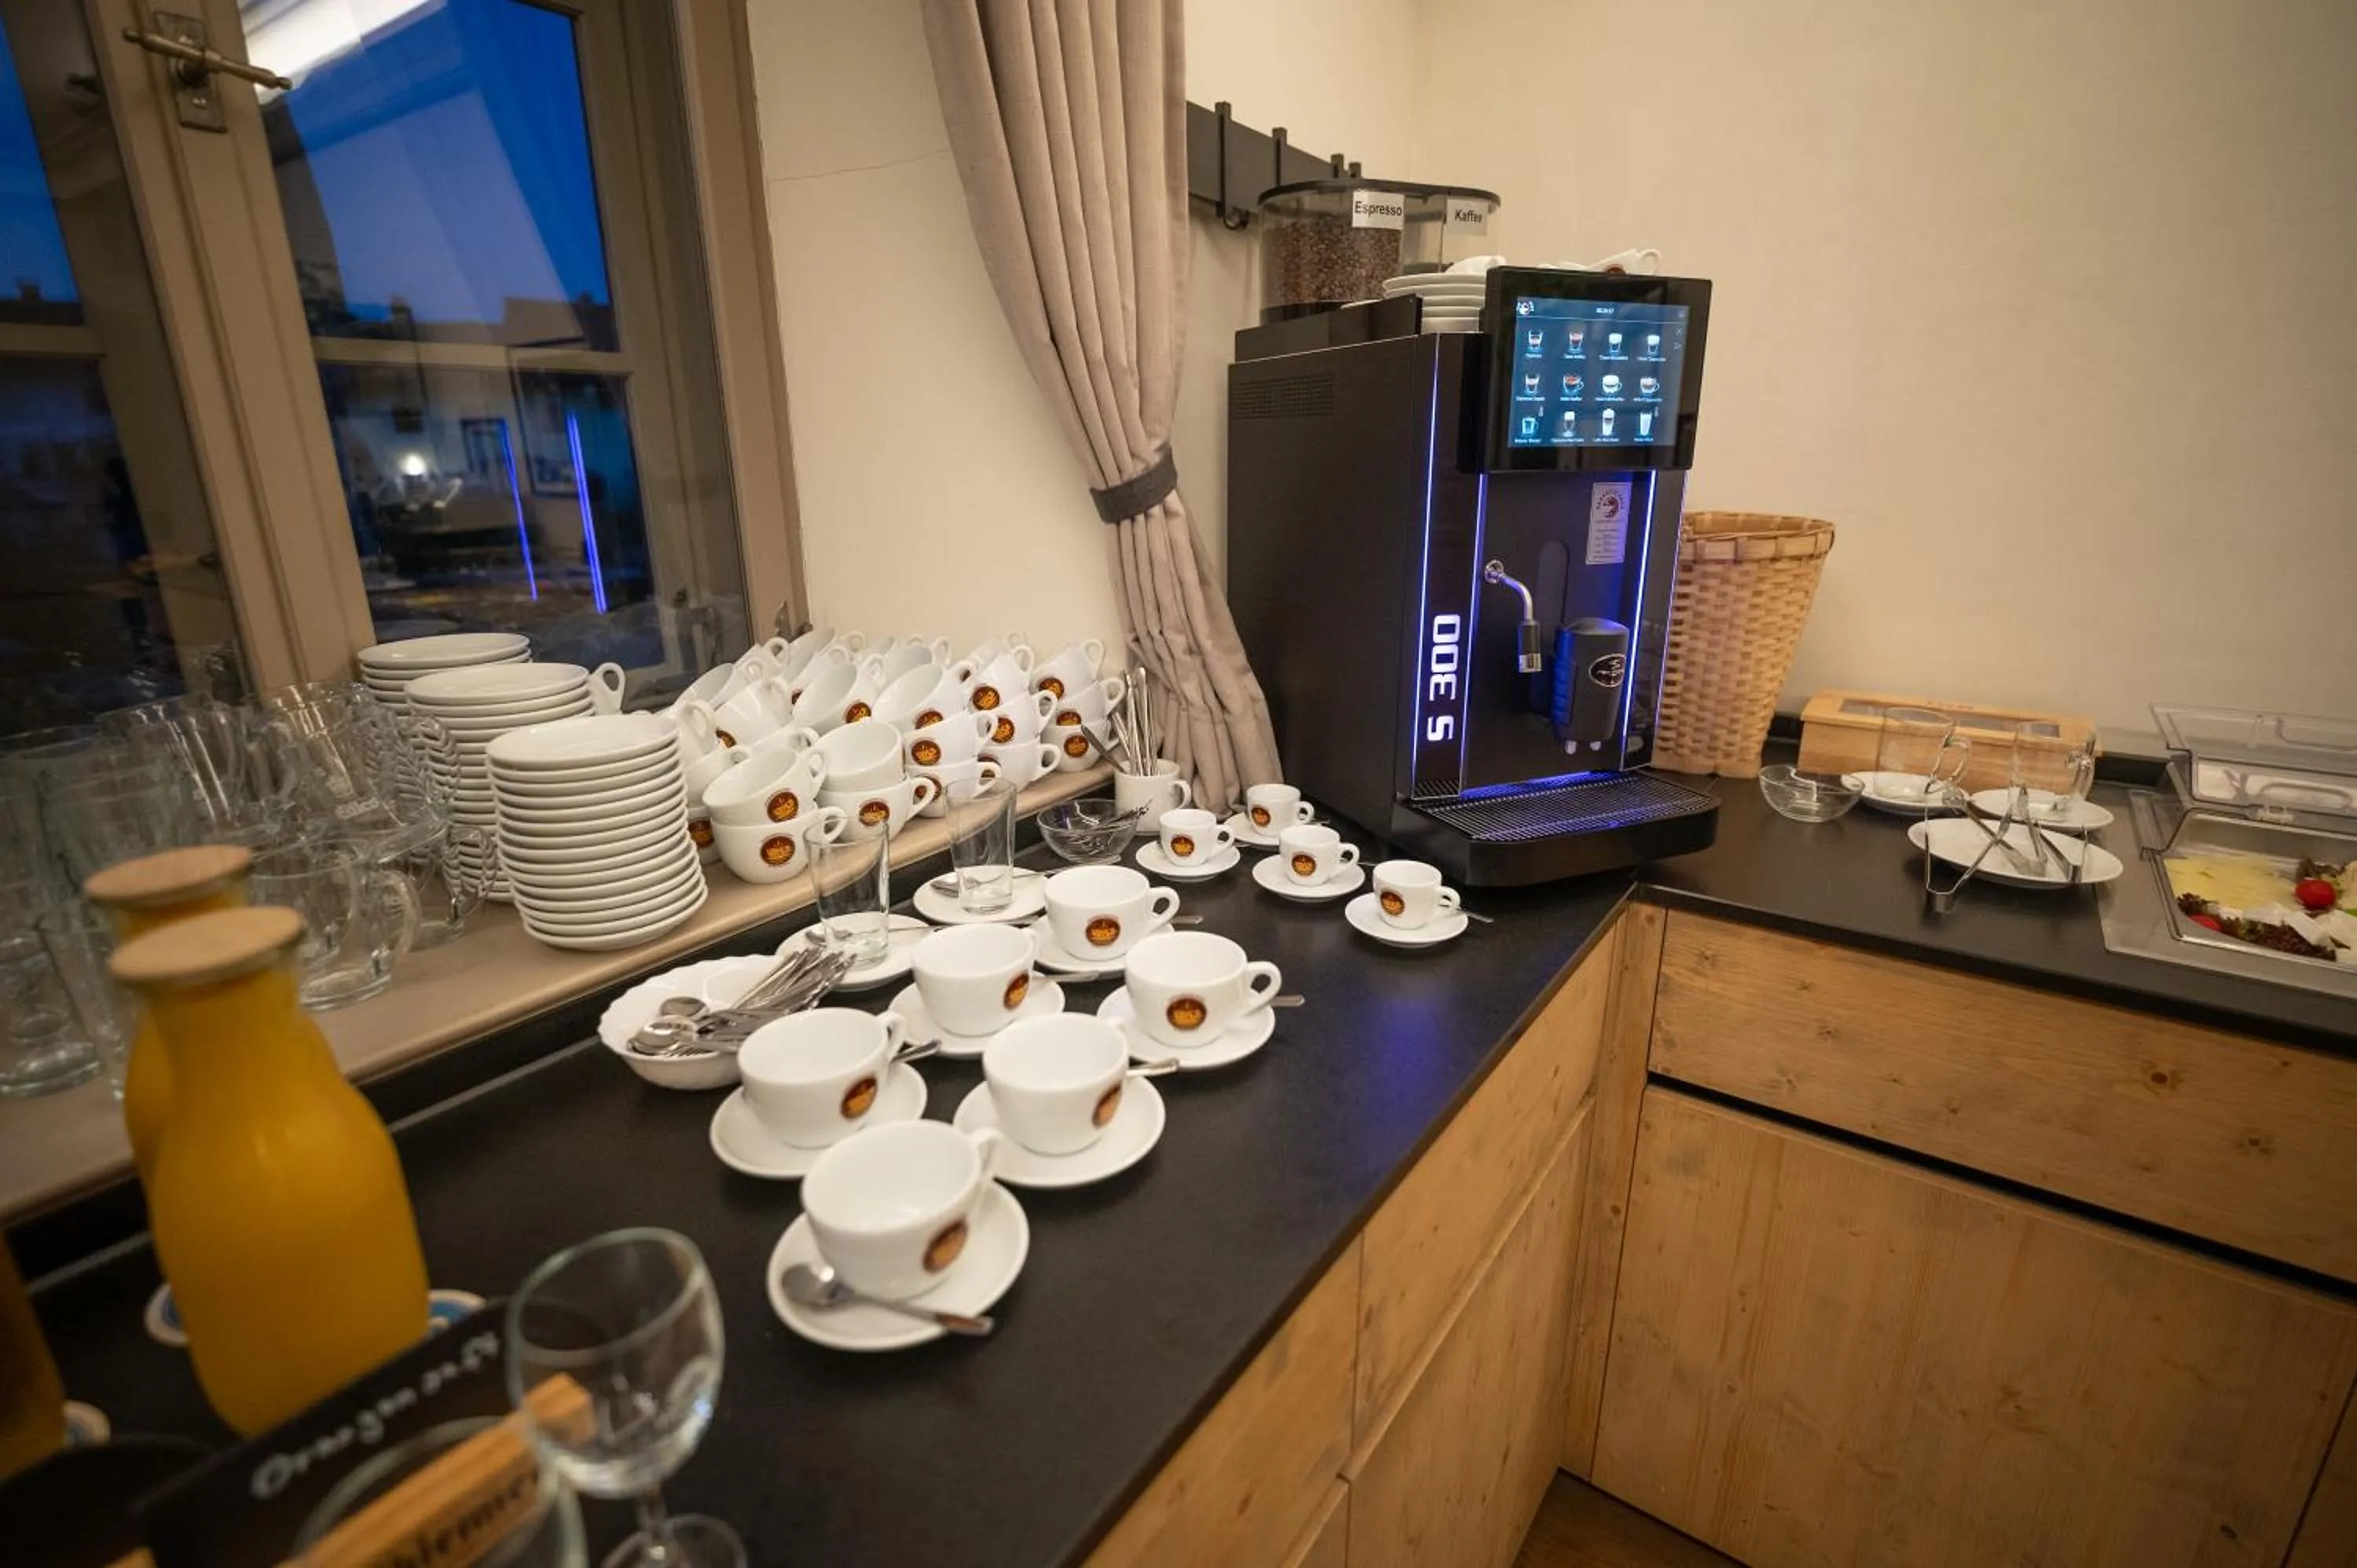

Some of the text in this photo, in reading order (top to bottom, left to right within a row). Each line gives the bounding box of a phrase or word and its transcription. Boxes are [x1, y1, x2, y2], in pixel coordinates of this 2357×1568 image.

[1354, 200, 1402, 217] Espresso
[1454, 208, 1483, 224] Kaffee
[1427, 614, 1461, 742] S 300
